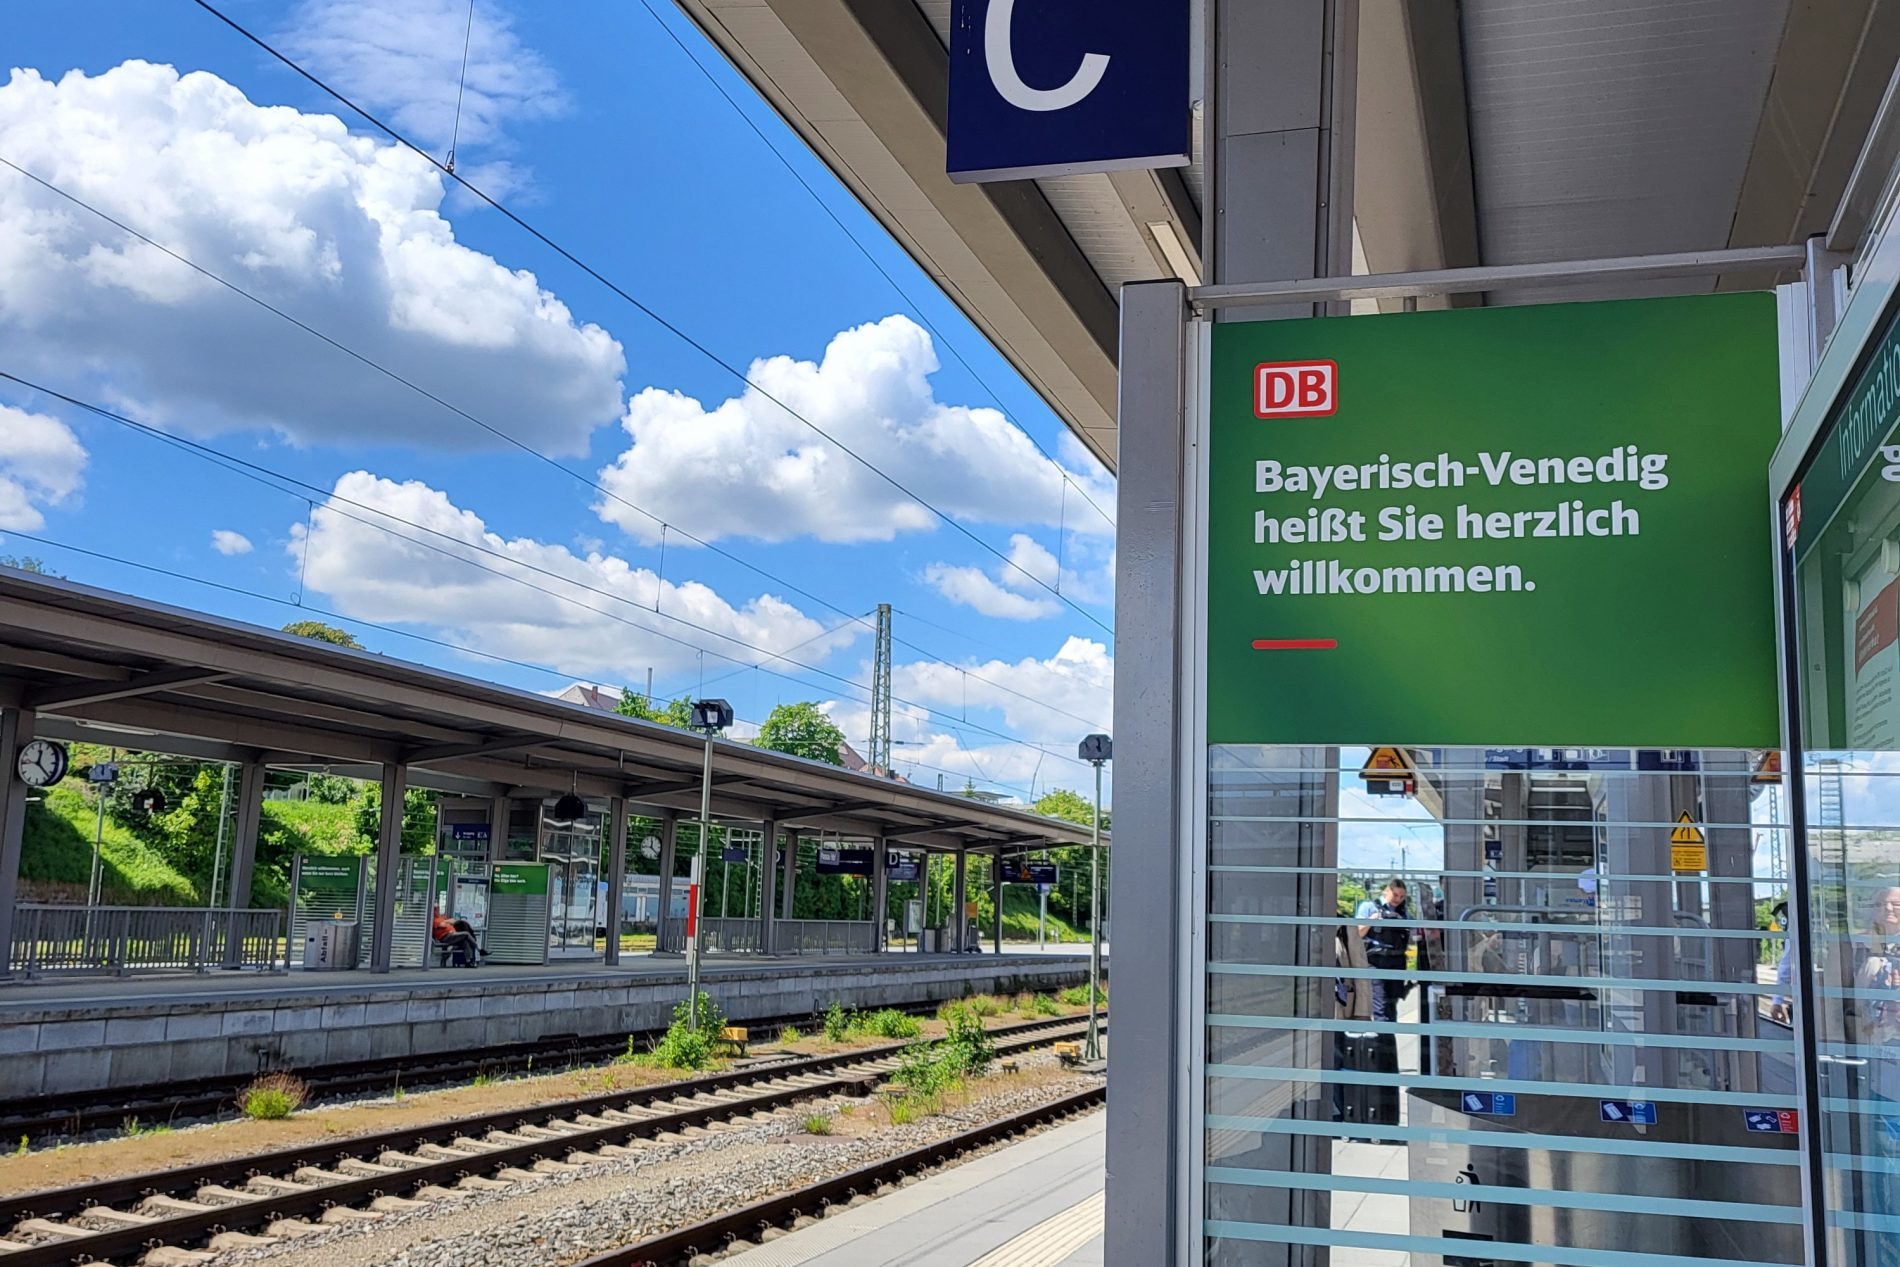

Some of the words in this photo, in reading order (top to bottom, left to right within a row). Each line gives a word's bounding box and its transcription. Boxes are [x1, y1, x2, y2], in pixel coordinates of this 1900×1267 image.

[984, 0, 1111, 112] C
[1263, 369, 1327, 410] DB
[1255, 445, 1669, 500] Bayerisch-Venedig
[1254, 507, 1367, 543] heißt
[1378, 505, 1444, 541] Sie
[1456, 501, 1639, 539] herzlich
[1253, 559, 1536, 595] willkommen.
[888, 853, 899, 865] D
[320, 936, 329, 963] Abfall
